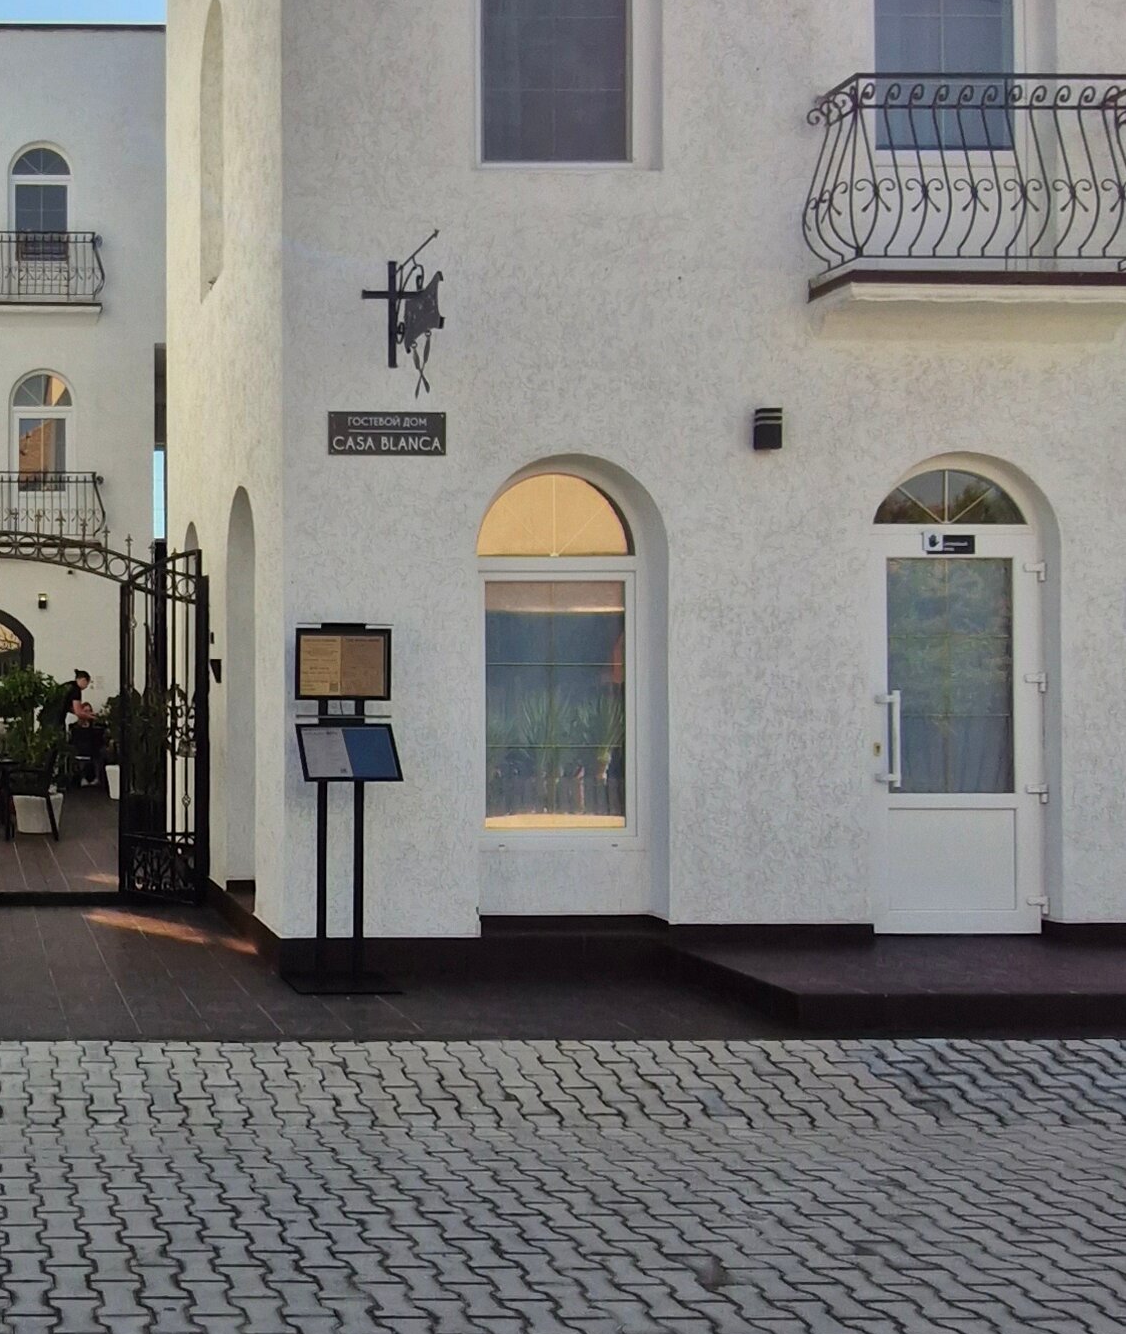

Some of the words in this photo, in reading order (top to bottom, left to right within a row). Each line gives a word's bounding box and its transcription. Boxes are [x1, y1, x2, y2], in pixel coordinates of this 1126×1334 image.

[347, 416, 400, 427] ГОСТЕВОЙ
[402, 417, 427, 427] ДОМ
[332, 436, 376, 451] CASA
[380, 436, 442, 451] BLANCA
